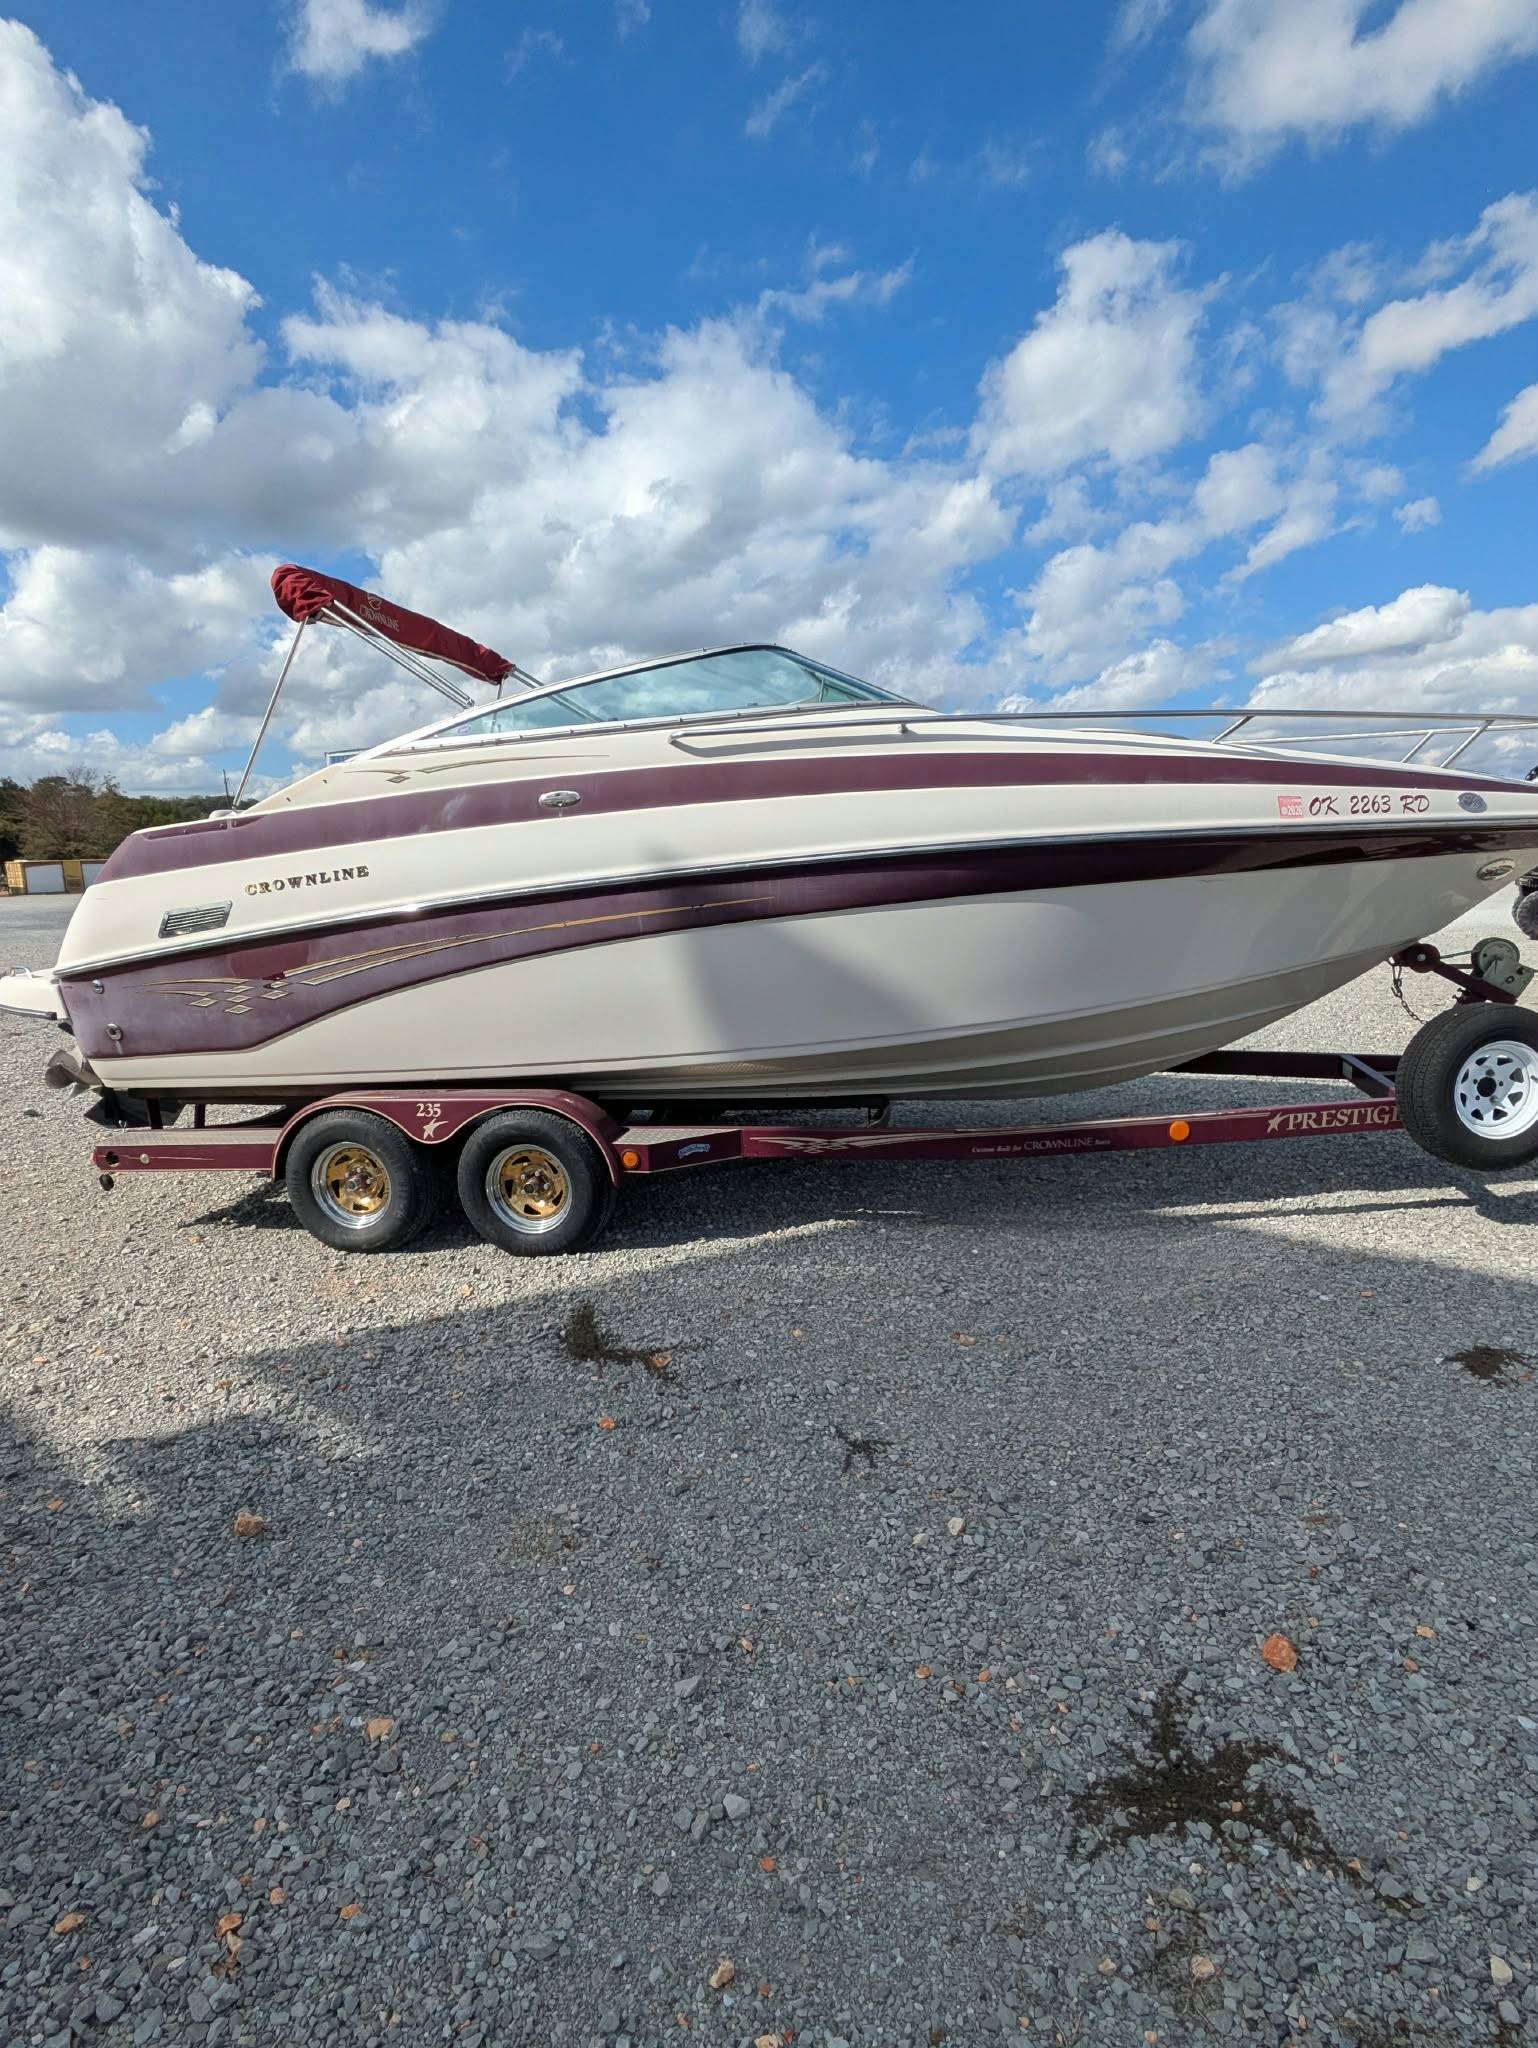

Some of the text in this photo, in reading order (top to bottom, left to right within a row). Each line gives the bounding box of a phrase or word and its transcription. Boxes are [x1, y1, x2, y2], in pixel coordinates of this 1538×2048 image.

[1309, 795, 1430, 815] OK 2263 RD
[245, 866, 369, 895] CROWNLINE
[416, 1103, 441, 1118] 235
[1024, 1137, 1093, 1150] CROWNLINE
